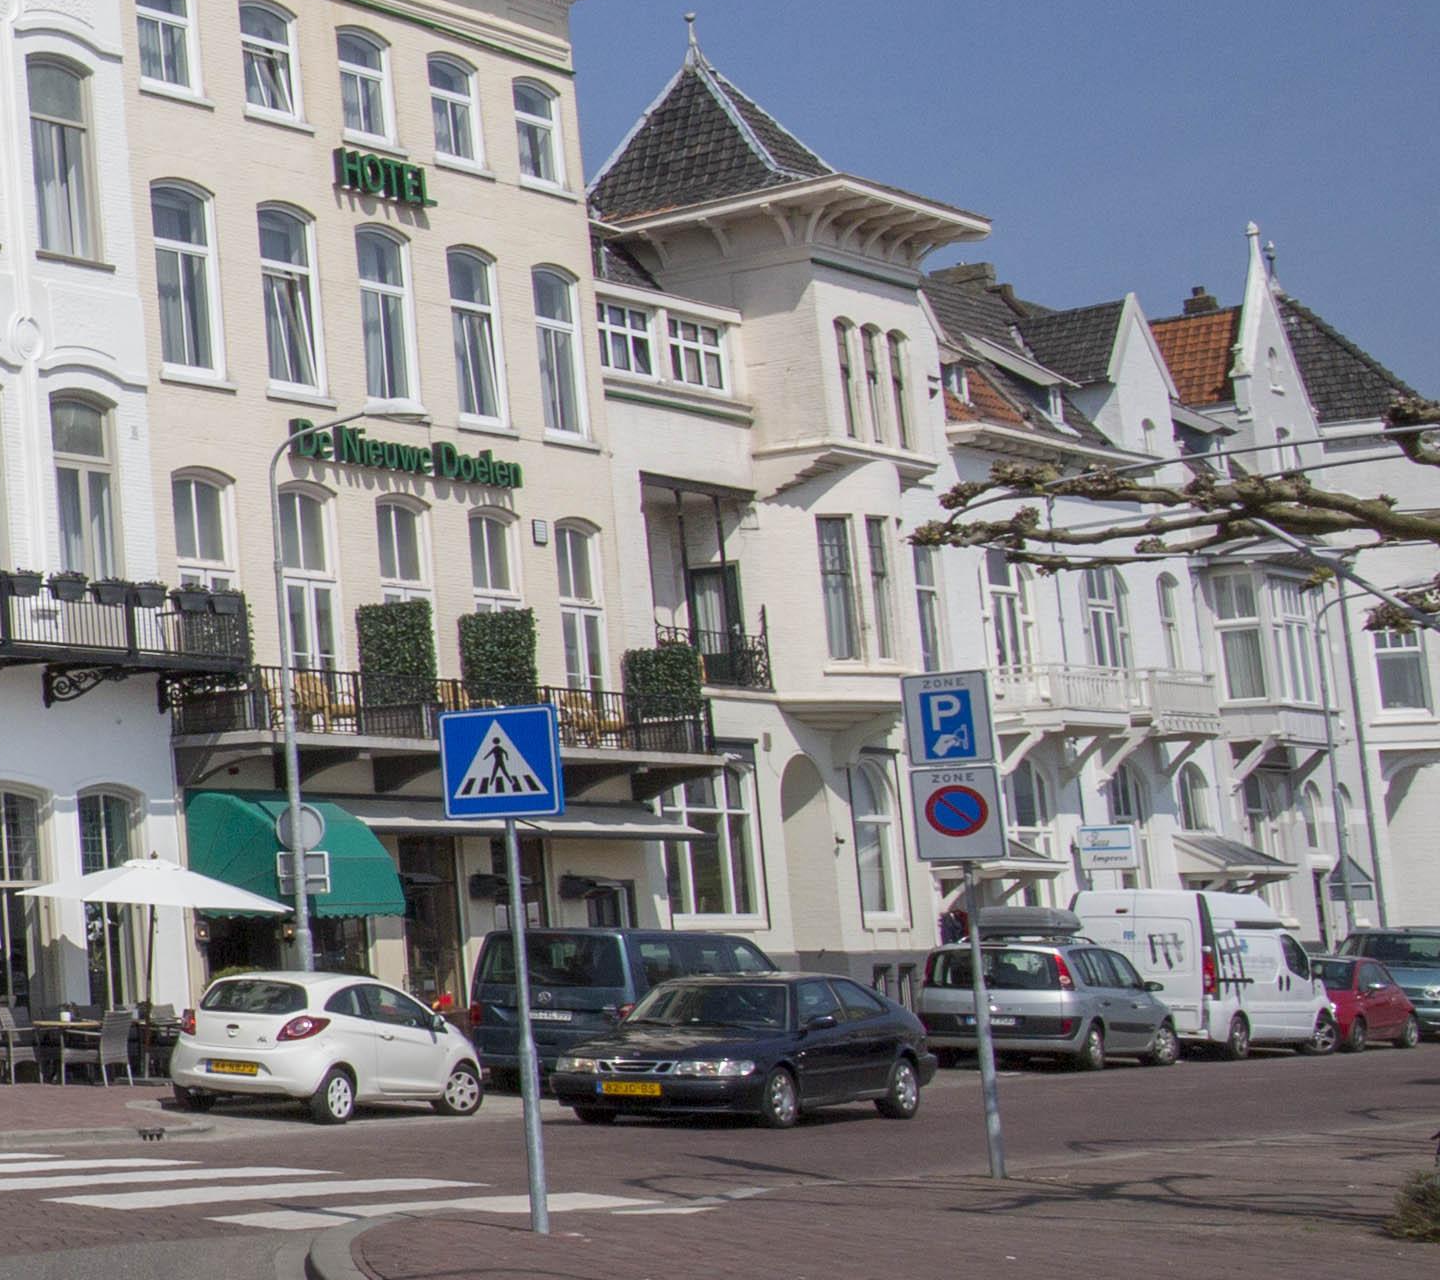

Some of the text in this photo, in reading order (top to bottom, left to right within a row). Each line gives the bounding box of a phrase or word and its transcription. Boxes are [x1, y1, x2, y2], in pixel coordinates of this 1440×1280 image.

[333, 146, 438, 209] HOTEL
[289, 417, 524, 489] De Nieuwe Doelen
[922, 677, 966, 689] ZONE
[929, 694, 961, 732] P
[931, 772, 976, 783] ZONE
